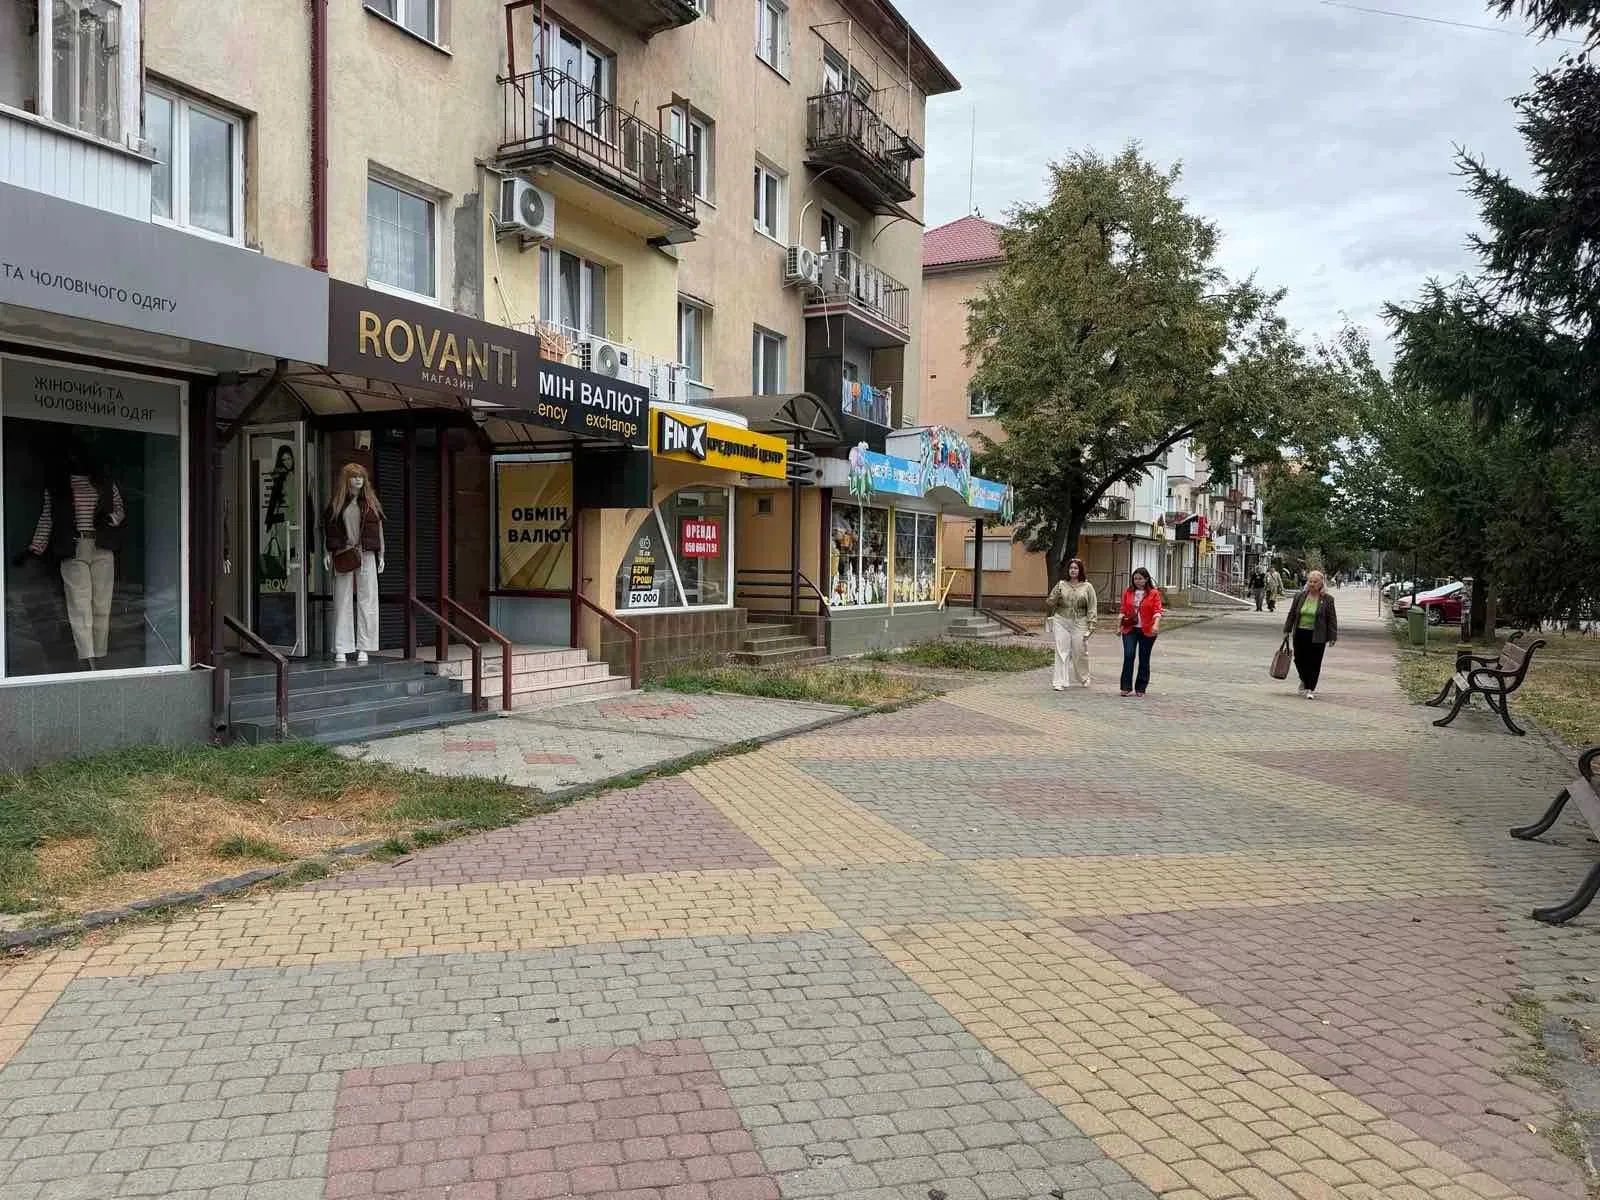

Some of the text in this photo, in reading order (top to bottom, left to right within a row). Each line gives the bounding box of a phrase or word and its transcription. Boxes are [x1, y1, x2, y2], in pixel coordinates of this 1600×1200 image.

[2, 263, 177, 312] ТА ЧОЛОВІЧОГО ОДЯГУ
[359, 310, 517, 388] ROVANTI
[33, 376, 124, 401] ЖІНОЧИЙ ТА
[421, 371, 474, 391] МАГАЗИН
[34, 395, 157, 422] ЧОЛОВІЧИЙ ОДЯГ
[581, 382, 643, 417] ВАЛЮТ
[586, 412, 637, 437] exchange
[511, 506, 567, 522] ОБМІН
[508, 528, 571, 543] ВАЛЮТ
[686, 524, 717, 541] ОРЕНДА
[631, 593, 657, 602] 50 000
